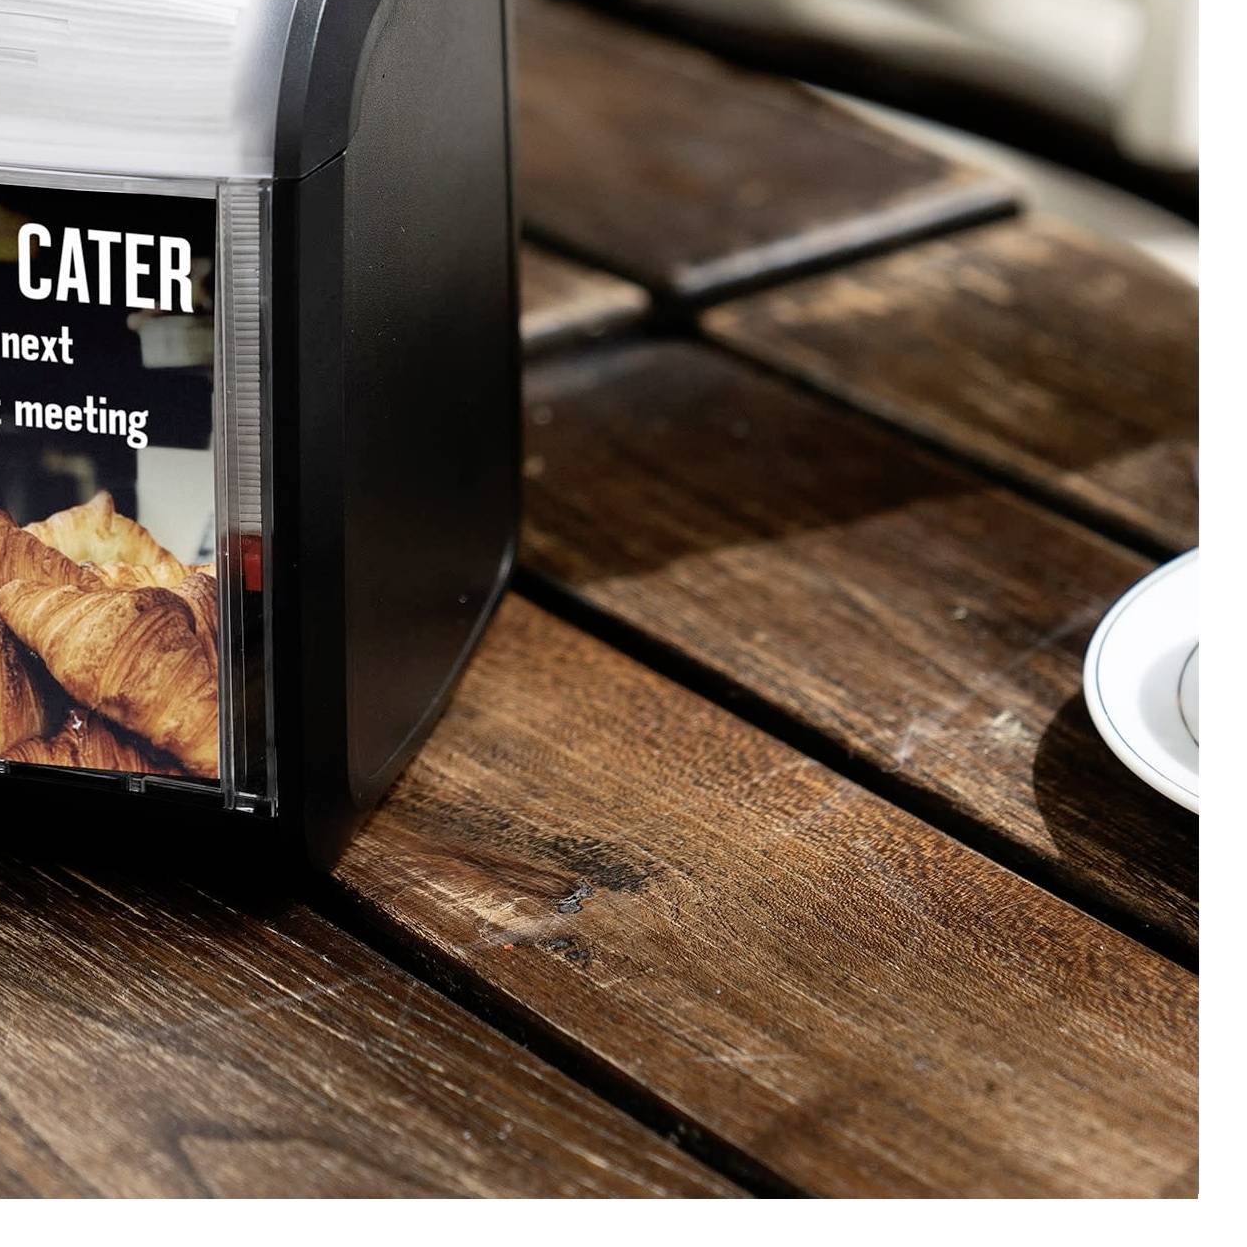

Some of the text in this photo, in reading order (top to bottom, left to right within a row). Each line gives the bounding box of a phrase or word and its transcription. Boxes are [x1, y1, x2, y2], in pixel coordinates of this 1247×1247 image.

[18, 222, 194, 313] CATER
[1, 325, 74, 365] next
[14, 395, 149, 449] meeting
